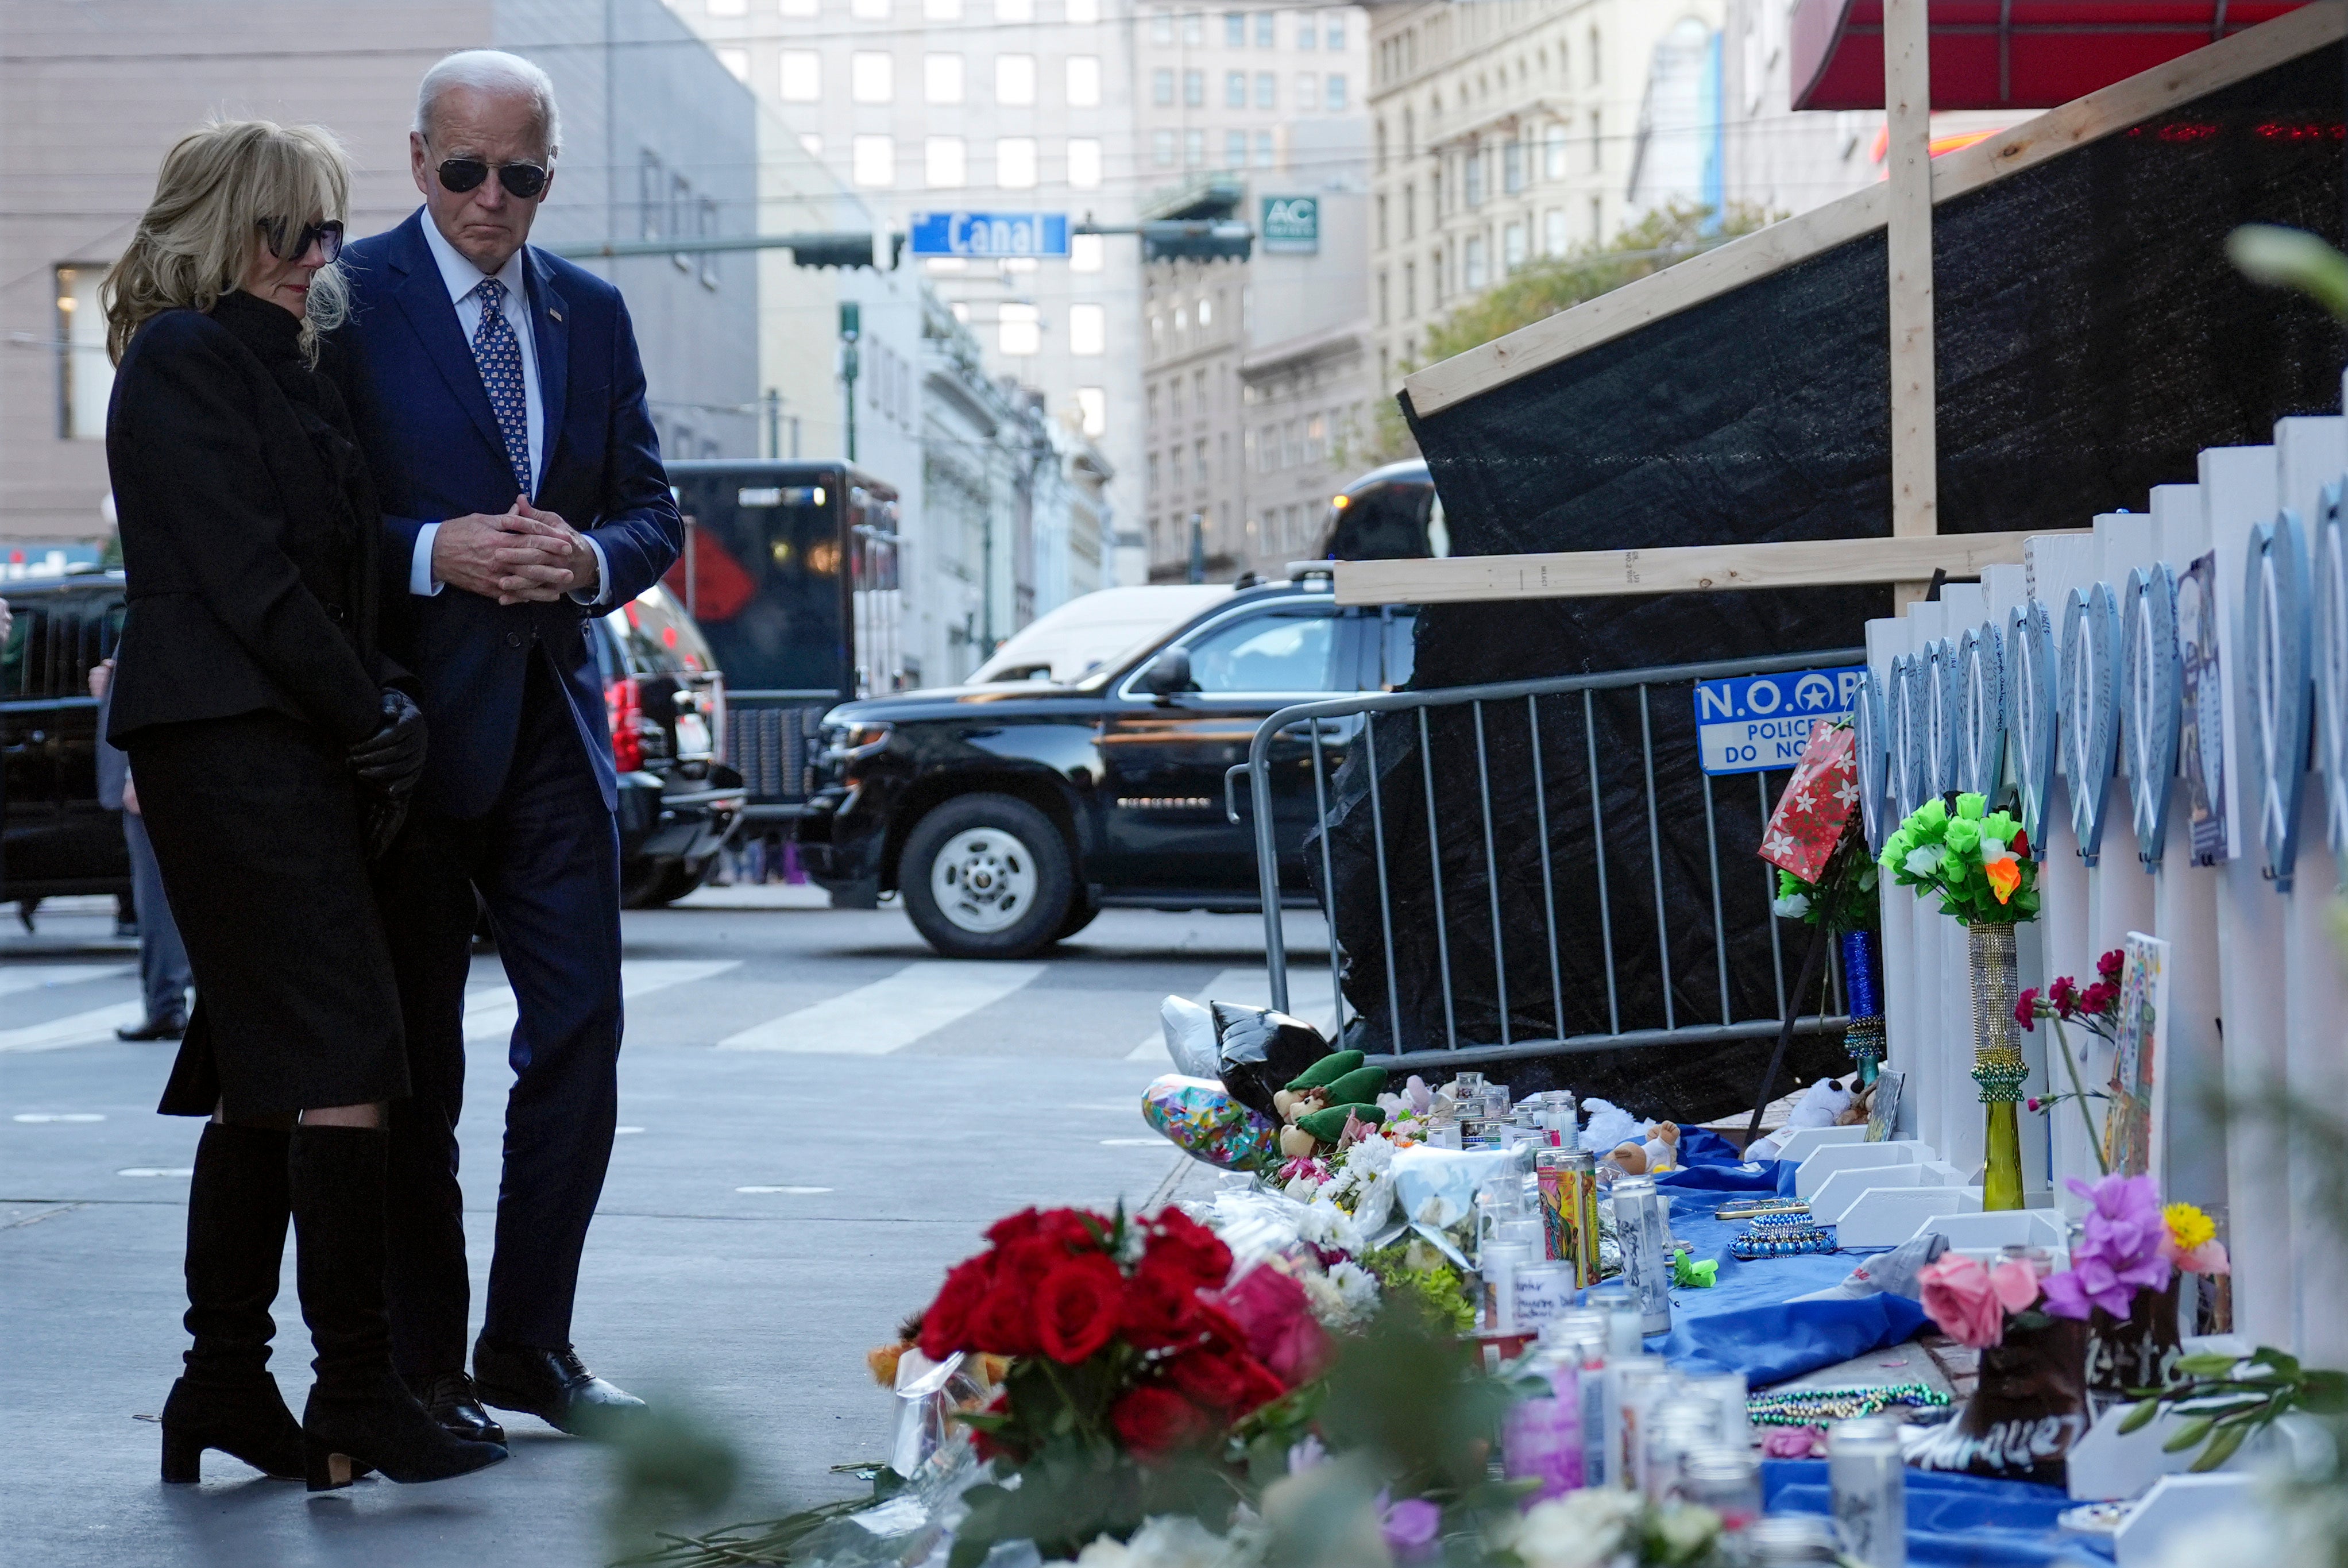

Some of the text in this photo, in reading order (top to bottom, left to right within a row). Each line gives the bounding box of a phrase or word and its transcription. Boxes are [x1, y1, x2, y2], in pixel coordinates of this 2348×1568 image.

[1266, 199, 1316, 224] AC
[948, 212, 1044, 253] Canal
[1725, 740, 1808, 763] DO NO
